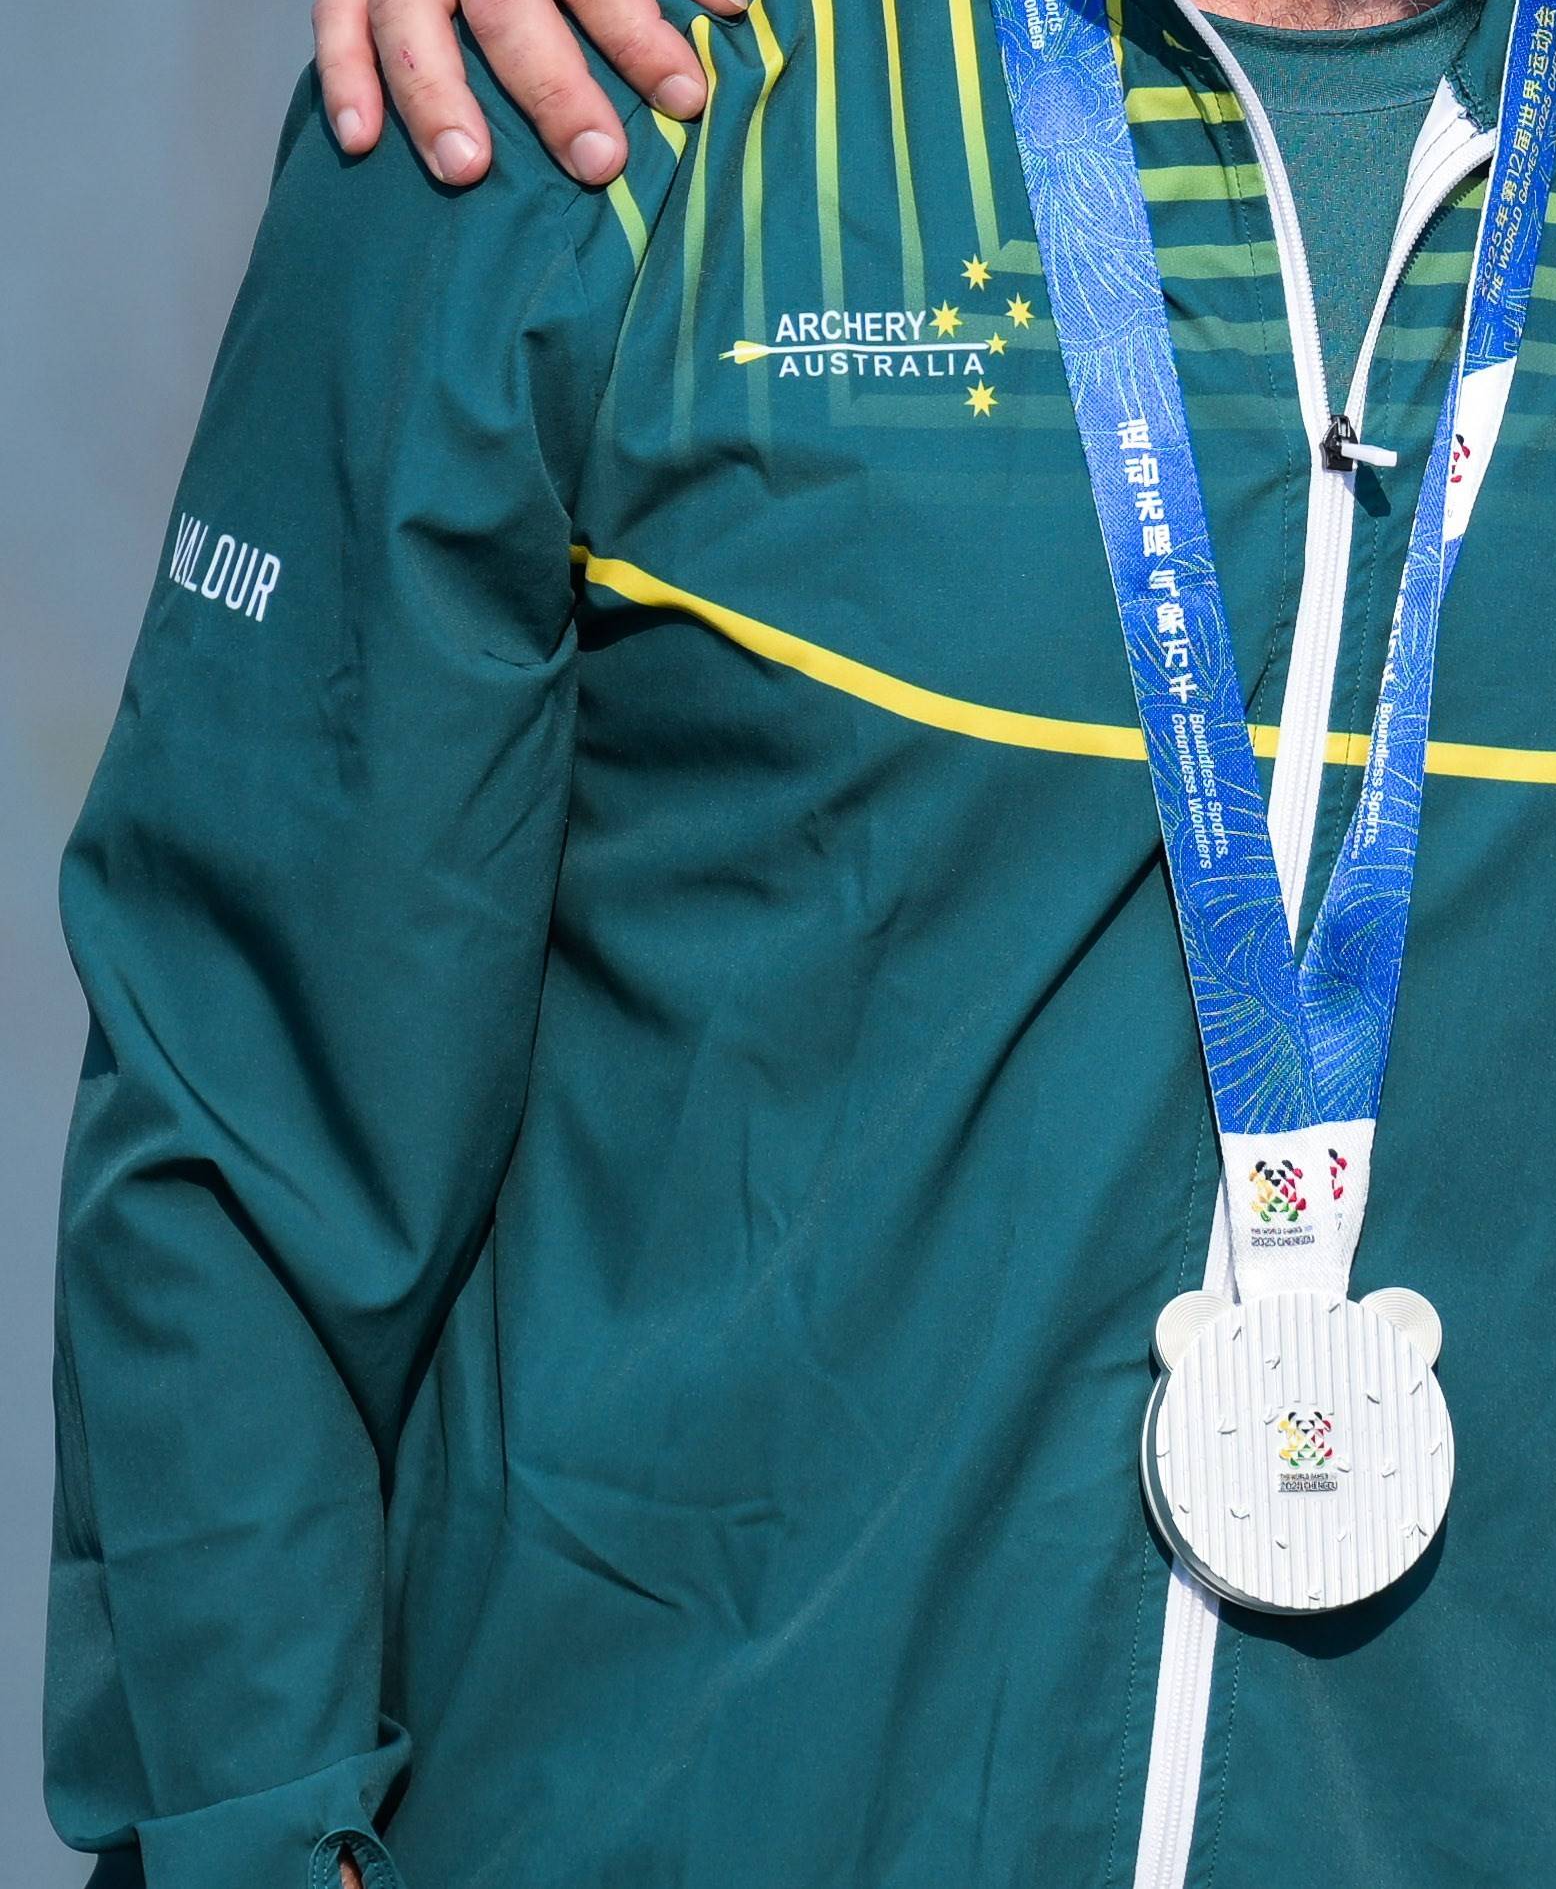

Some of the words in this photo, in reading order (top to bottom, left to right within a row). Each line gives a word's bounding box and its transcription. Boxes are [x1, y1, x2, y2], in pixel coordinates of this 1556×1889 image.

[1486, 274, 1506, 306] THE
[1499, 207, 1524, 275] WORLD
[1518, 146, 1540, 206] GAMES
[1534, 95, 1552, 143] 2025
[775, 310, 926, 343] ARCHERY
[778, 352, 985, 378] AUSTRALIA
[169, 512, 281, 623] VALOUR
[1117, 420, 1174, 558] 运动无限
[1148, 569, 1200, 706] 气象万千
[1170, 712, 1198, 796] Countless
[1186, 795, 1213, 871] Wonders
[1188, 709, 1219, 800] Boundless
[1209, 800, 1230, 861] Sports,
[1373, 703, 1393, 787] Boundless
[1251, 1236, 1277, 1247] 2025
